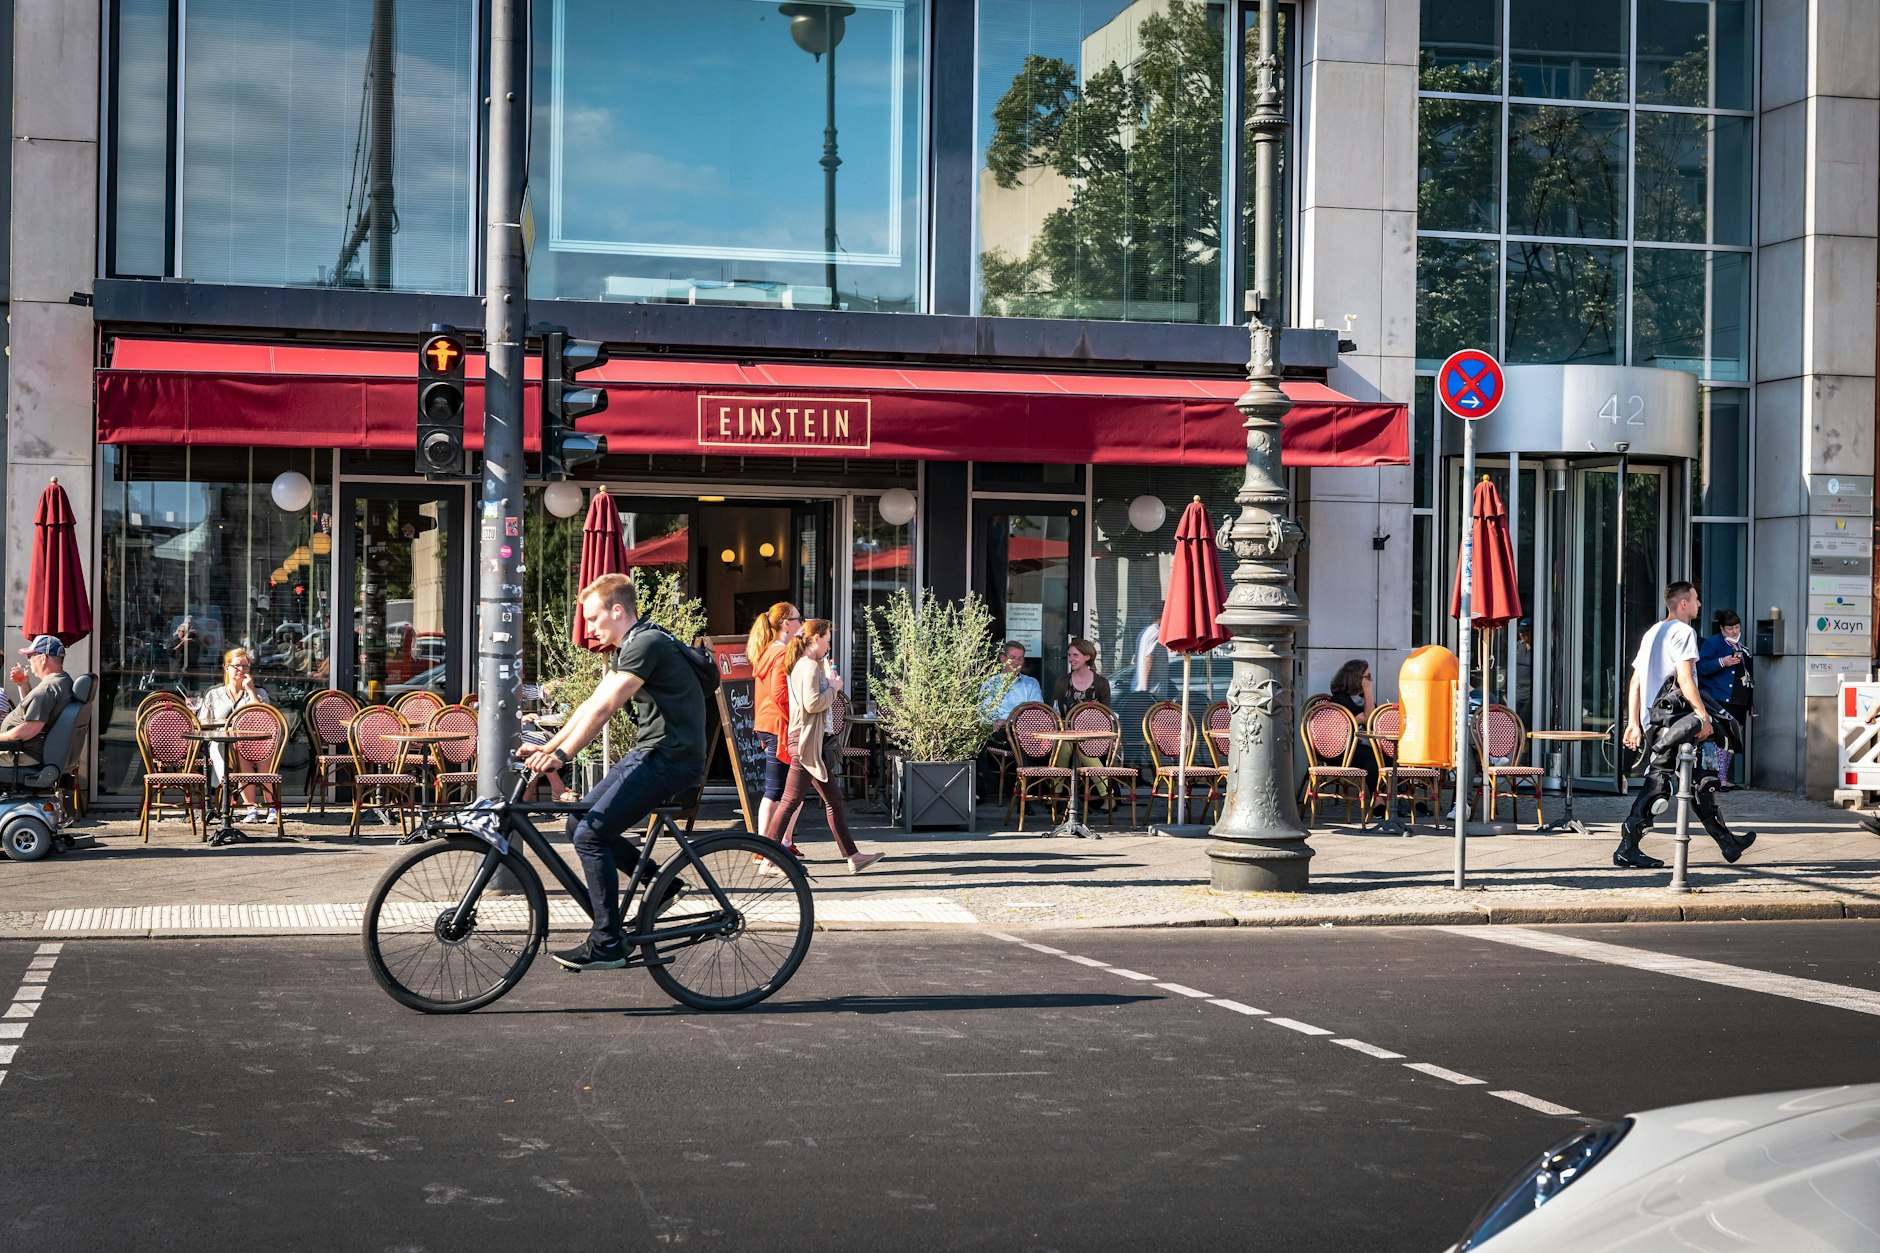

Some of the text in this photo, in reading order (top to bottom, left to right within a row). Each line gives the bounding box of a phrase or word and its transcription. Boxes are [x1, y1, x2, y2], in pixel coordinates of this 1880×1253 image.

[719, 407, 849, 437] EINSTEIN
[1598, 392, 1646, 426] 42
[1833, 619, 1863, 633] Xayn
